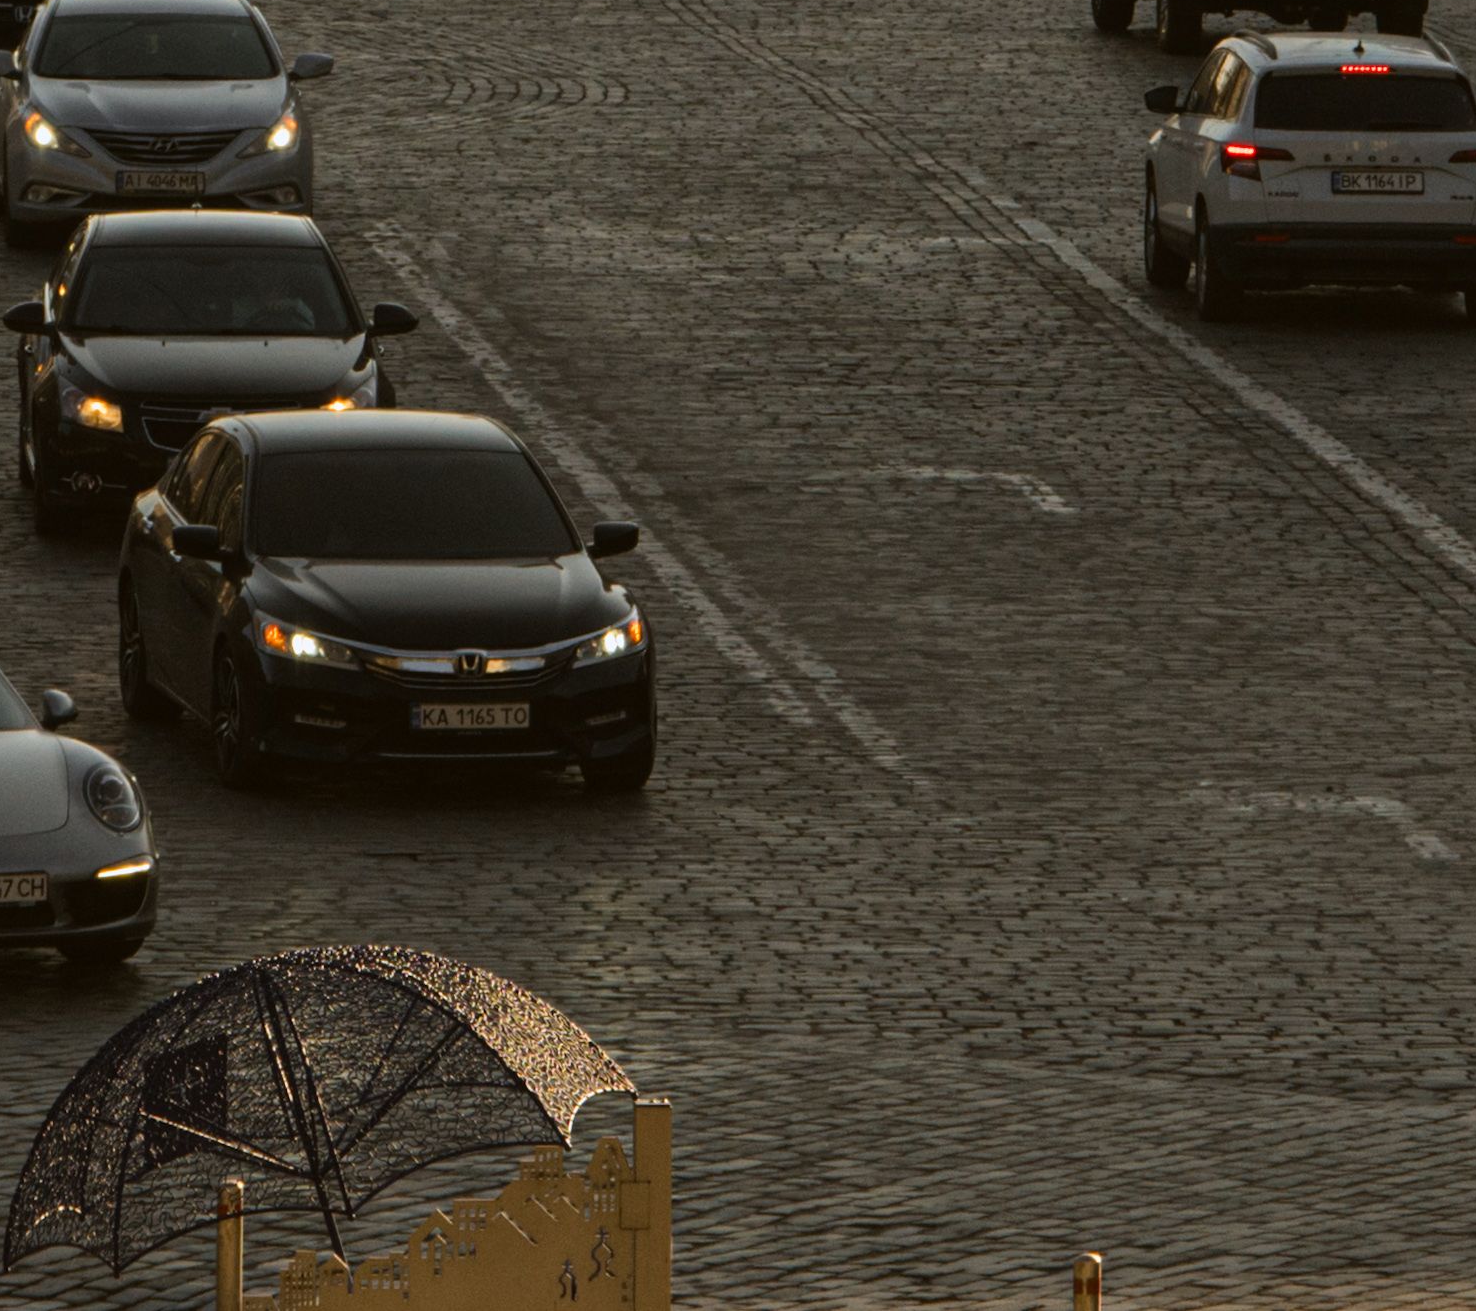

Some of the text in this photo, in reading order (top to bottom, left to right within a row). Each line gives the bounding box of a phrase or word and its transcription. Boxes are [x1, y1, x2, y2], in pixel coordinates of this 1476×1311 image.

[1341, 176, 1416, 189] BK 1164 IP
[422, 703, 527, 725] KA 1165 TO
[16, 877, 45, 898] CH
